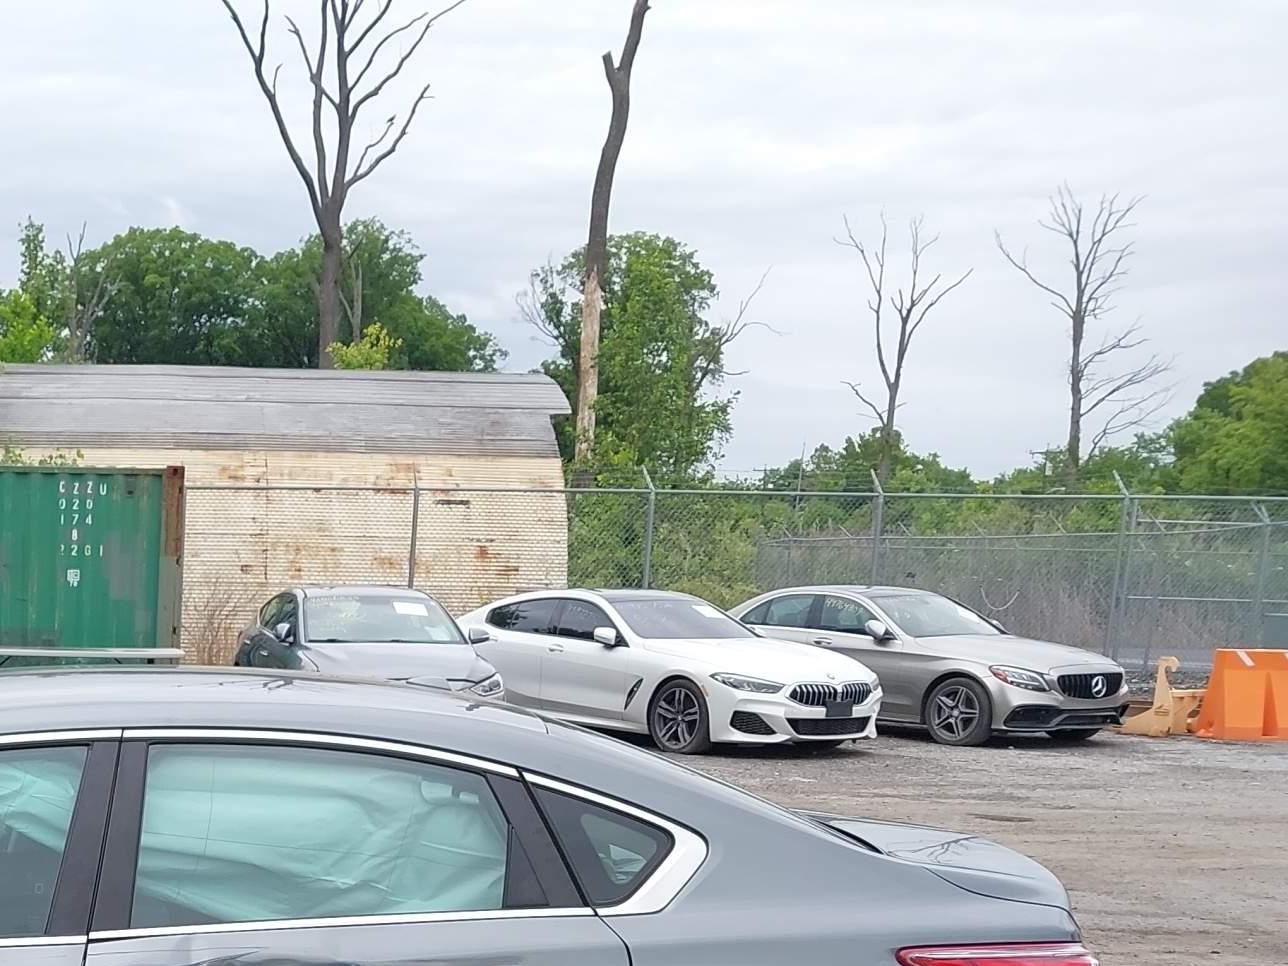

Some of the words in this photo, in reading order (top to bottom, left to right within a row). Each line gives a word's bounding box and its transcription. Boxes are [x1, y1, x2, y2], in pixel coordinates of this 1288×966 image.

[59, 481, 107, 495] CZZU
[58, 499, 93, 510] 020
[60, 513, 92, 525] 174
[71, 529, 78, 541] 8
